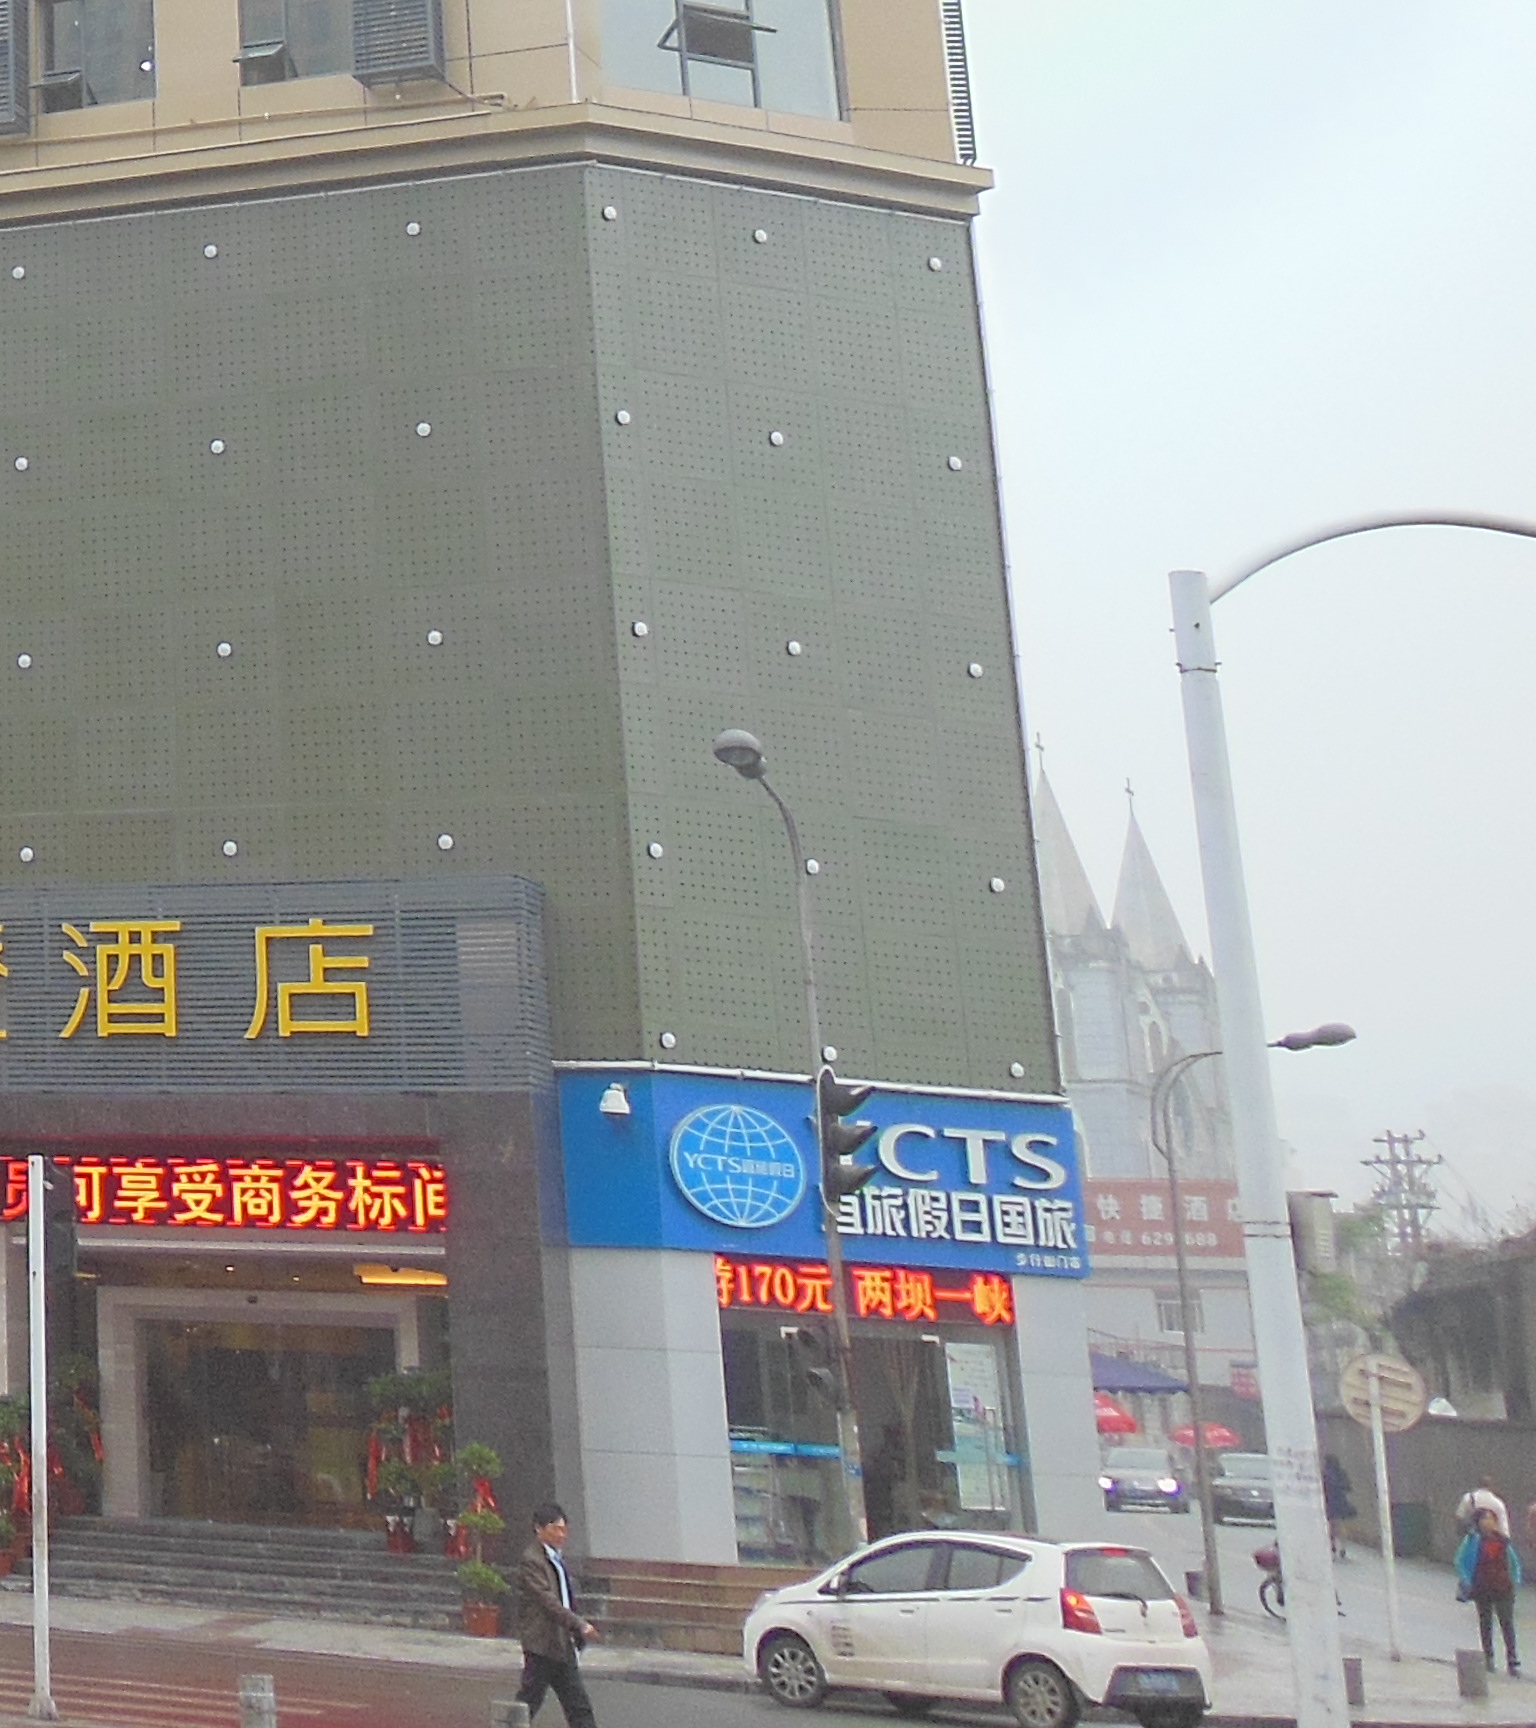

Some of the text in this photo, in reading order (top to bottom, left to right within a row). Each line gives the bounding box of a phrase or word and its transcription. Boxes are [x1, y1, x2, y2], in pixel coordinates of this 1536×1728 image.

[807, 1116, 1068, 1191] CTS
[851, 1265, 1015, 1325] 两坝一峡
